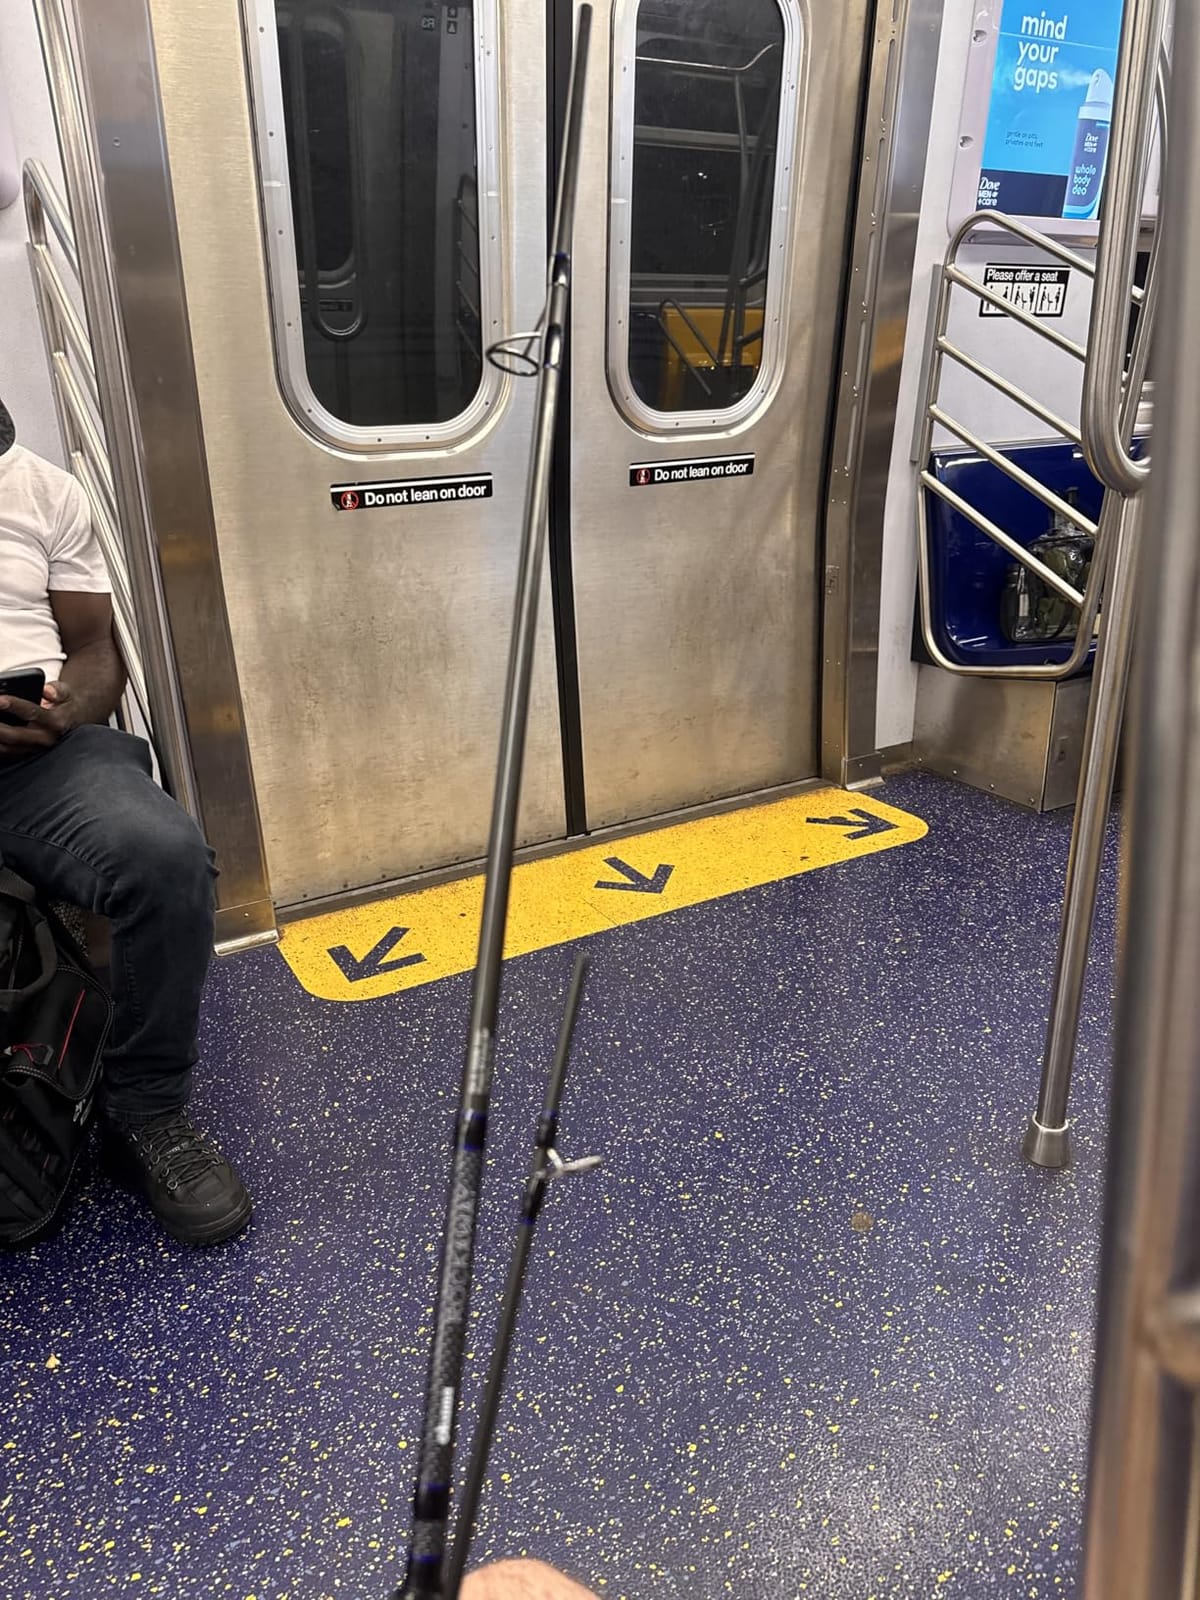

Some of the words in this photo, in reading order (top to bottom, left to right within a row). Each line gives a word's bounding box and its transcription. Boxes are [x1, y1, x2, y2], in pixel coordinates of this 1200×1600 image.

[1021, 10, 1068, 40] mind
[1016, 41, 1059, 66] your
[1013, 66, 1058, 94] gaps
[1075, 163, 1097, 175] whole
[980, 176, 1000, 190] Dove
[1073, 174, 1091, 187] body
[1072, 184, 1087, 195] deo
[987, 268, 1014, 281] Please
[1015, 269, 1034, 281] offer
[1034, 272, 1040, 281] a
[1041, 271, 1058, 282] seat
[654, 469, 670, 481] Do
[671, 467, 688, 479] not
[689, 466, 709, 478] lean
[711, 465, 724, 476] on
[725, 462, 748, 474] door
[364, 491, 385, 506] Do
[386, 492, 408, 504] not
[411, 487, 438, 502] lean
[440, 487, 457, 499] on
[458, 484, 487, 497] door
